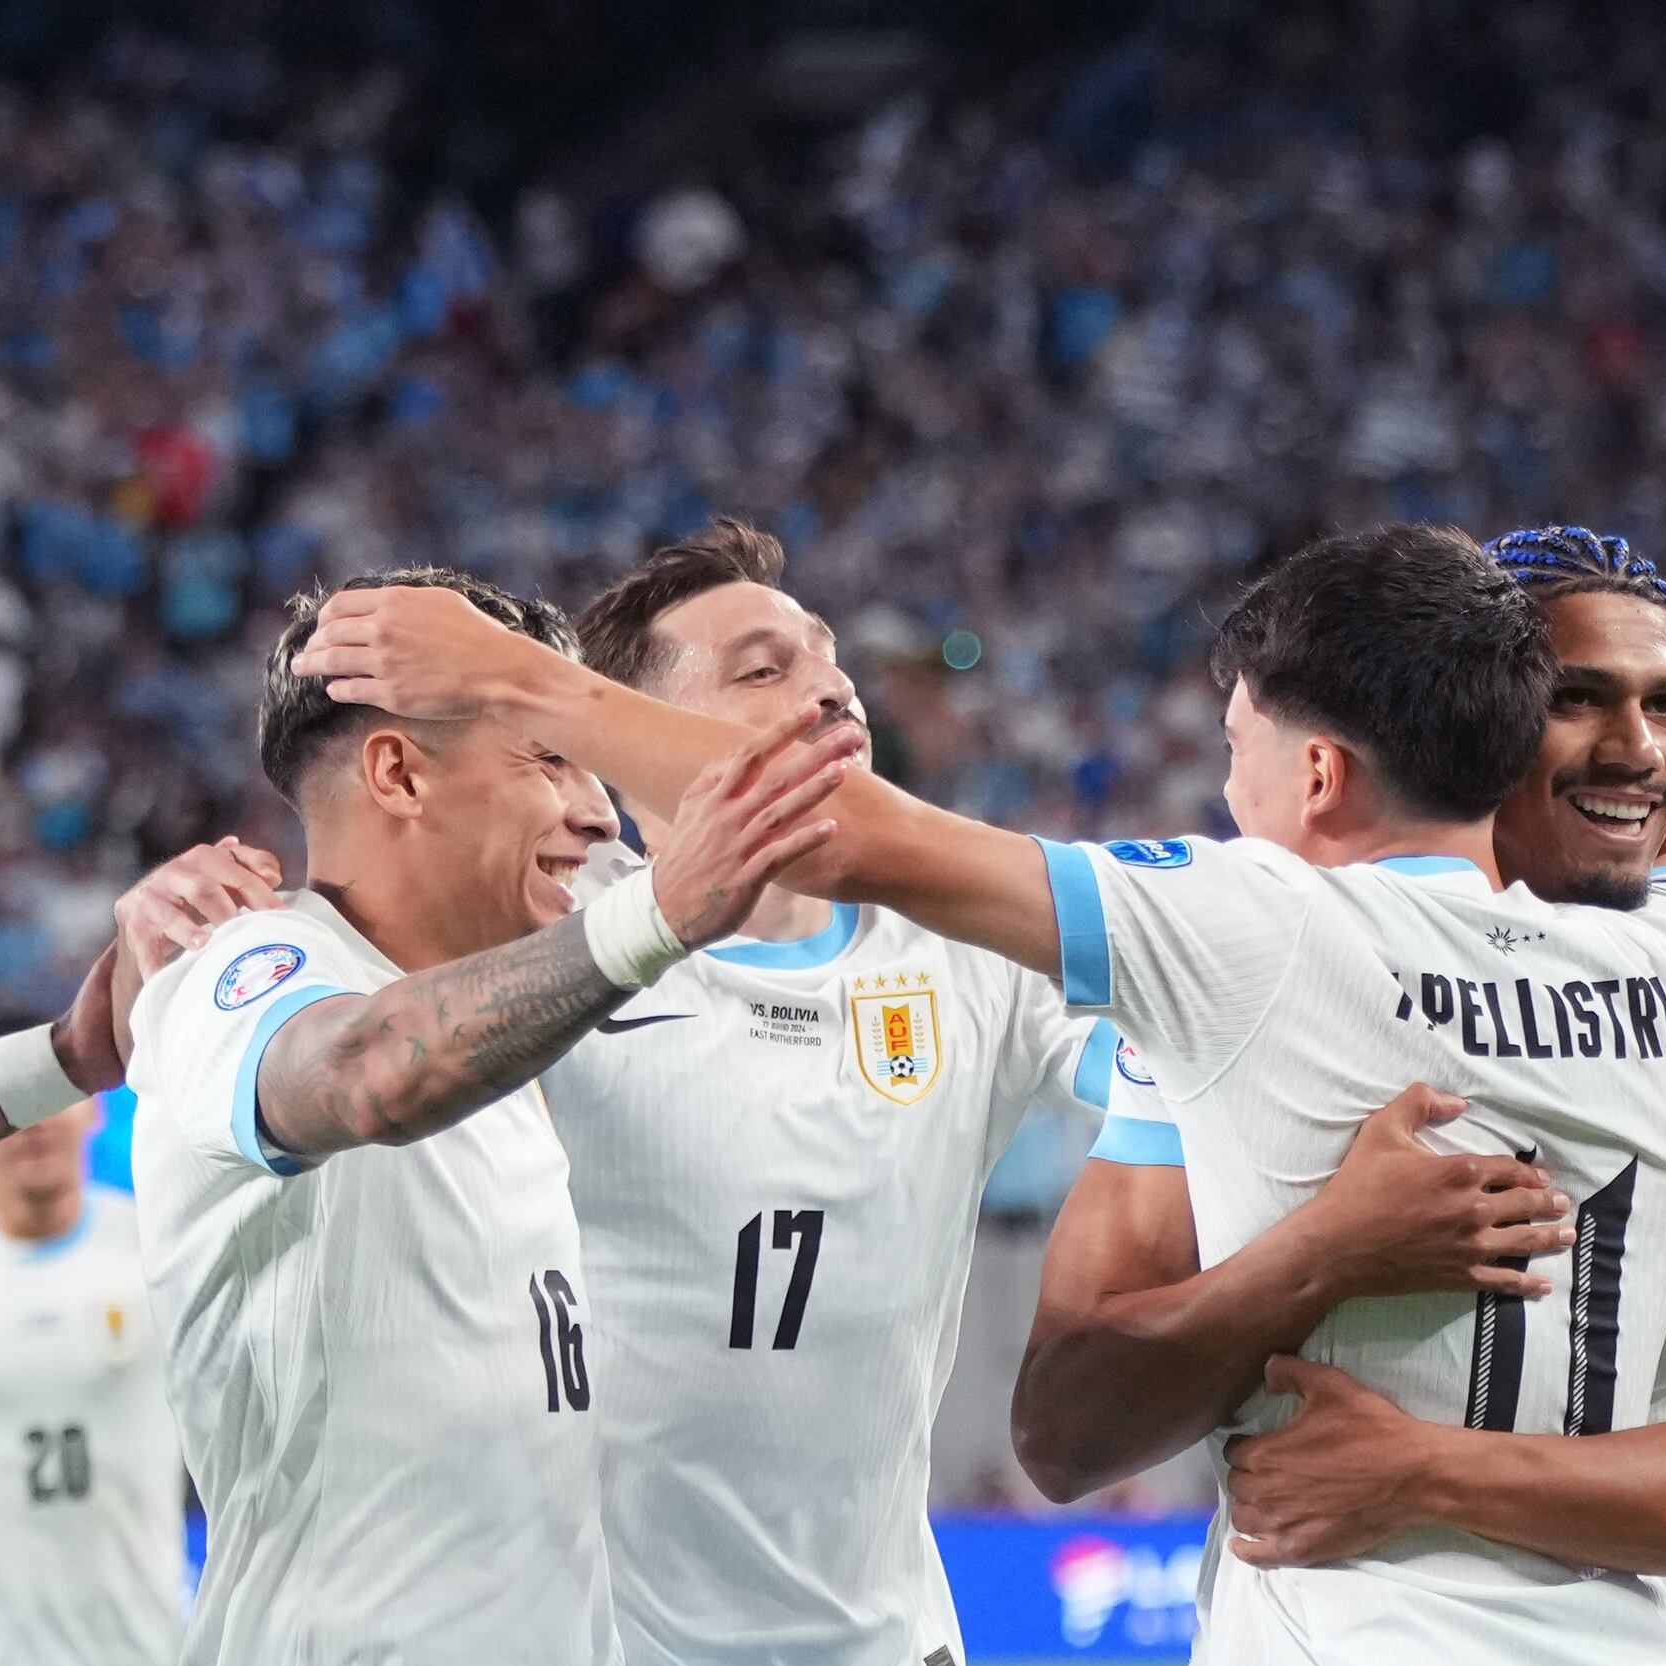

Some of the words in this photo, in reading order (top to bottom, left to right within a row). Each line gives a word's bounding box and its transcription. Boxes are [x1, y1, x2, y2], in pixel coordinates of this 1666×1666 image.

[750, 1003, 768, 1018] VS.
[771, 1005, 819, 1022] BOLIVIA
[750, 1028, 768, 1040] EAST
[769, 1032, 822, 1047] RUTHERFORD
[889, 1013, 910, 1052] AUF
[729, 1210, 824, 1350] 17
[529, 1270, 591, 1412] 16
[26, 1424, 92, 1502] 20
